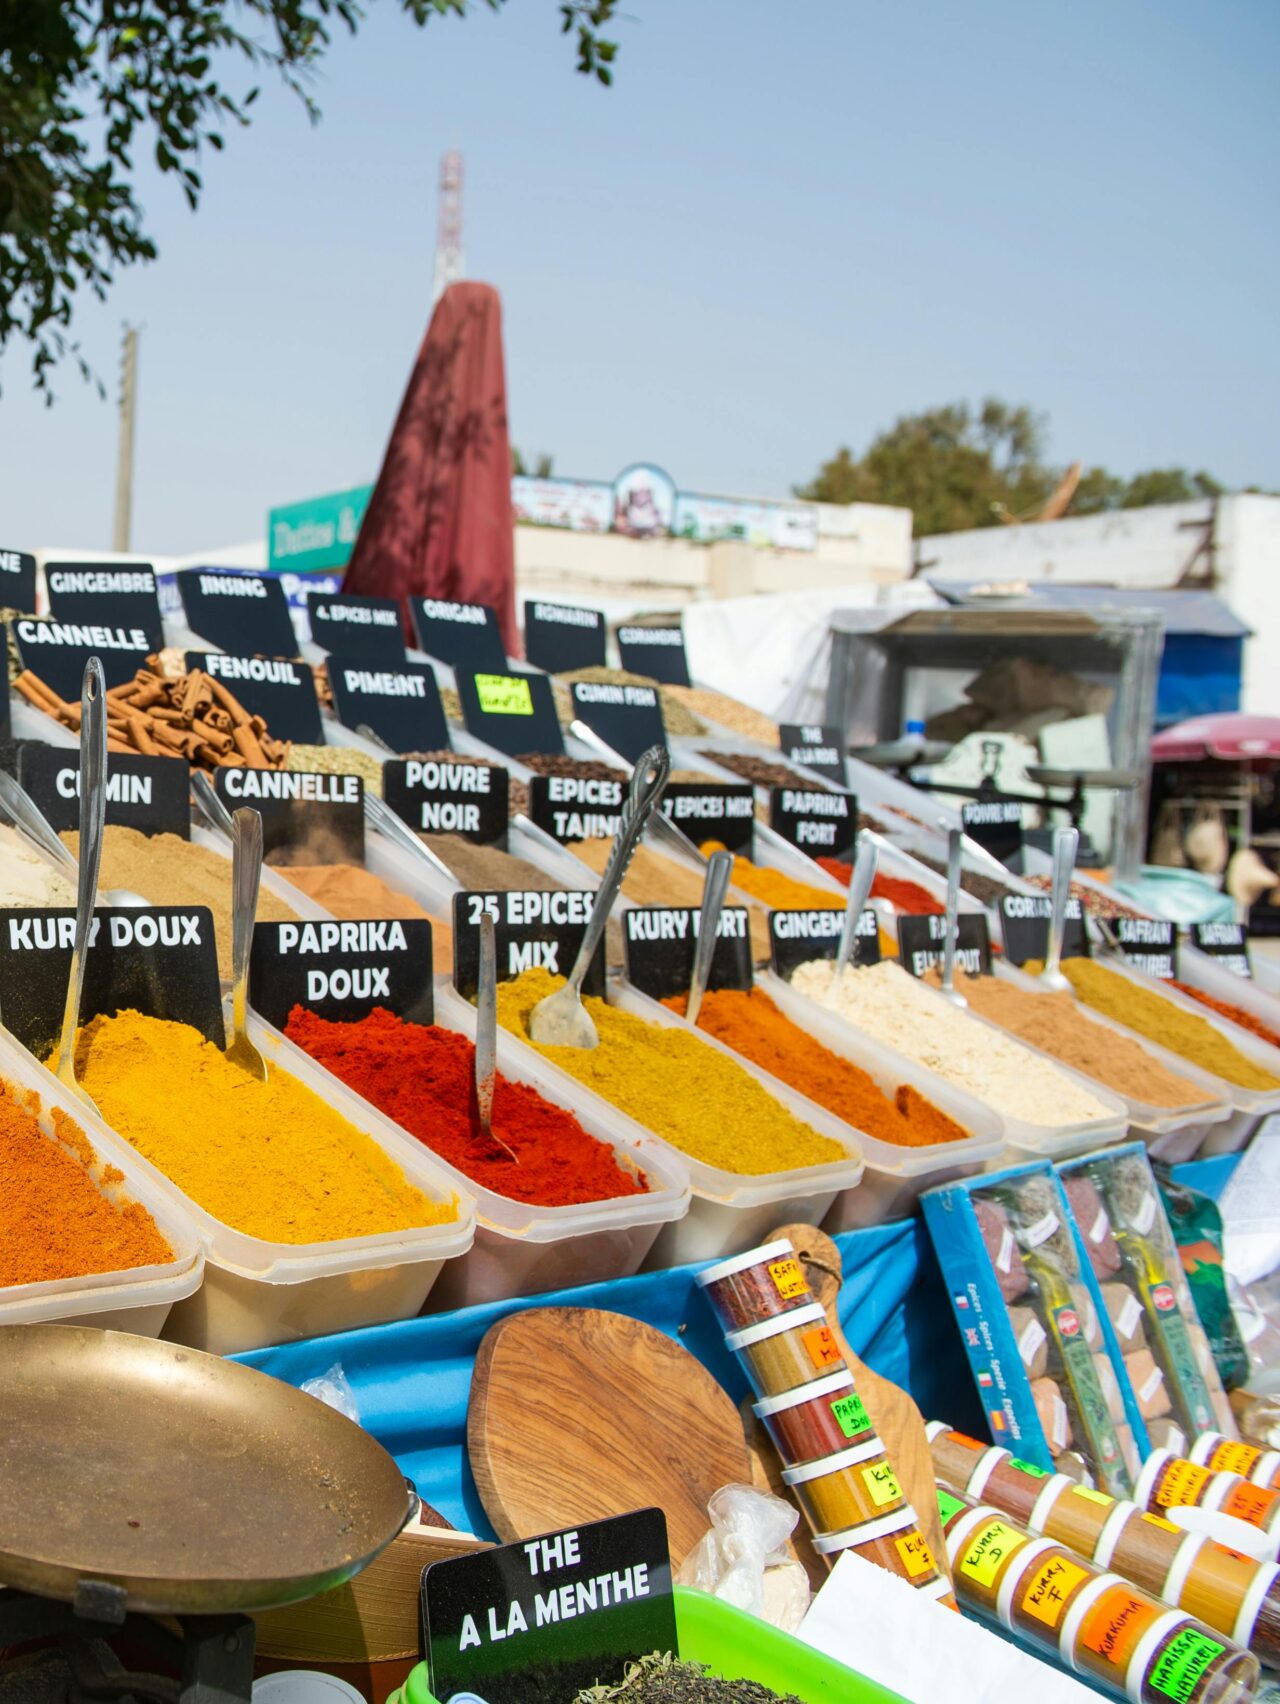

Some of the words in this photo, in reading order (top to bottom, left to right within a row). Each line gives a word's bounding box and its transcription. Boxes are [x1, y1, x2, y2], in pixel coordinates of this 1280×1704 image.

[50, 571, 156, 594] GINGEMBRE
[199, 574, 267, 598] JINSING
[330, 605, 372, 625] EPICES
[423, 599, 487, 625] ORIGAN
[18, 621, 150, 651] CANNELLE
[205, 654, 302, 685] FENOUIL
[224, 768, 359, 803] CANNELLE
[406, 760, 491, 794] POIVRE
[548, 777, 622, 806] EPICES
[422, 800, 480, 832] NOIR
[674, 796, 725, 818] EPICES
[725, 796, 754, 818] MIX
[782, 791, 848, 817] PAPRIKA
[553, 812, 622, 838] TAJIN
[796, 821, 837, 845] FORT
[468, 896, 499, 924] 25
[507, 892, 595, 924] EPICES
[110, 915, 202, 947] DOUX
[279, 921, 407, 954] PAPRIKA
[628, 911, 689, 941] KURY
[773, 911, 877, 939] GINGEMRE
[508, 941, 560, 974] MIX
[307, 967, 390, 1001] DOUX
[524, 1531, 581, 1576] THE
[459, 1614, 482, 1651] A
[488, 1601, 528, 1641] LA
[535, 1563, 650, 1627] MENTHE
[1098, 1600, 1144, 1660] KURKUMA
[1155, 1631, 1200, 1689] HARISSA
[1174, 1644, 1219, 1704] NATUREL
